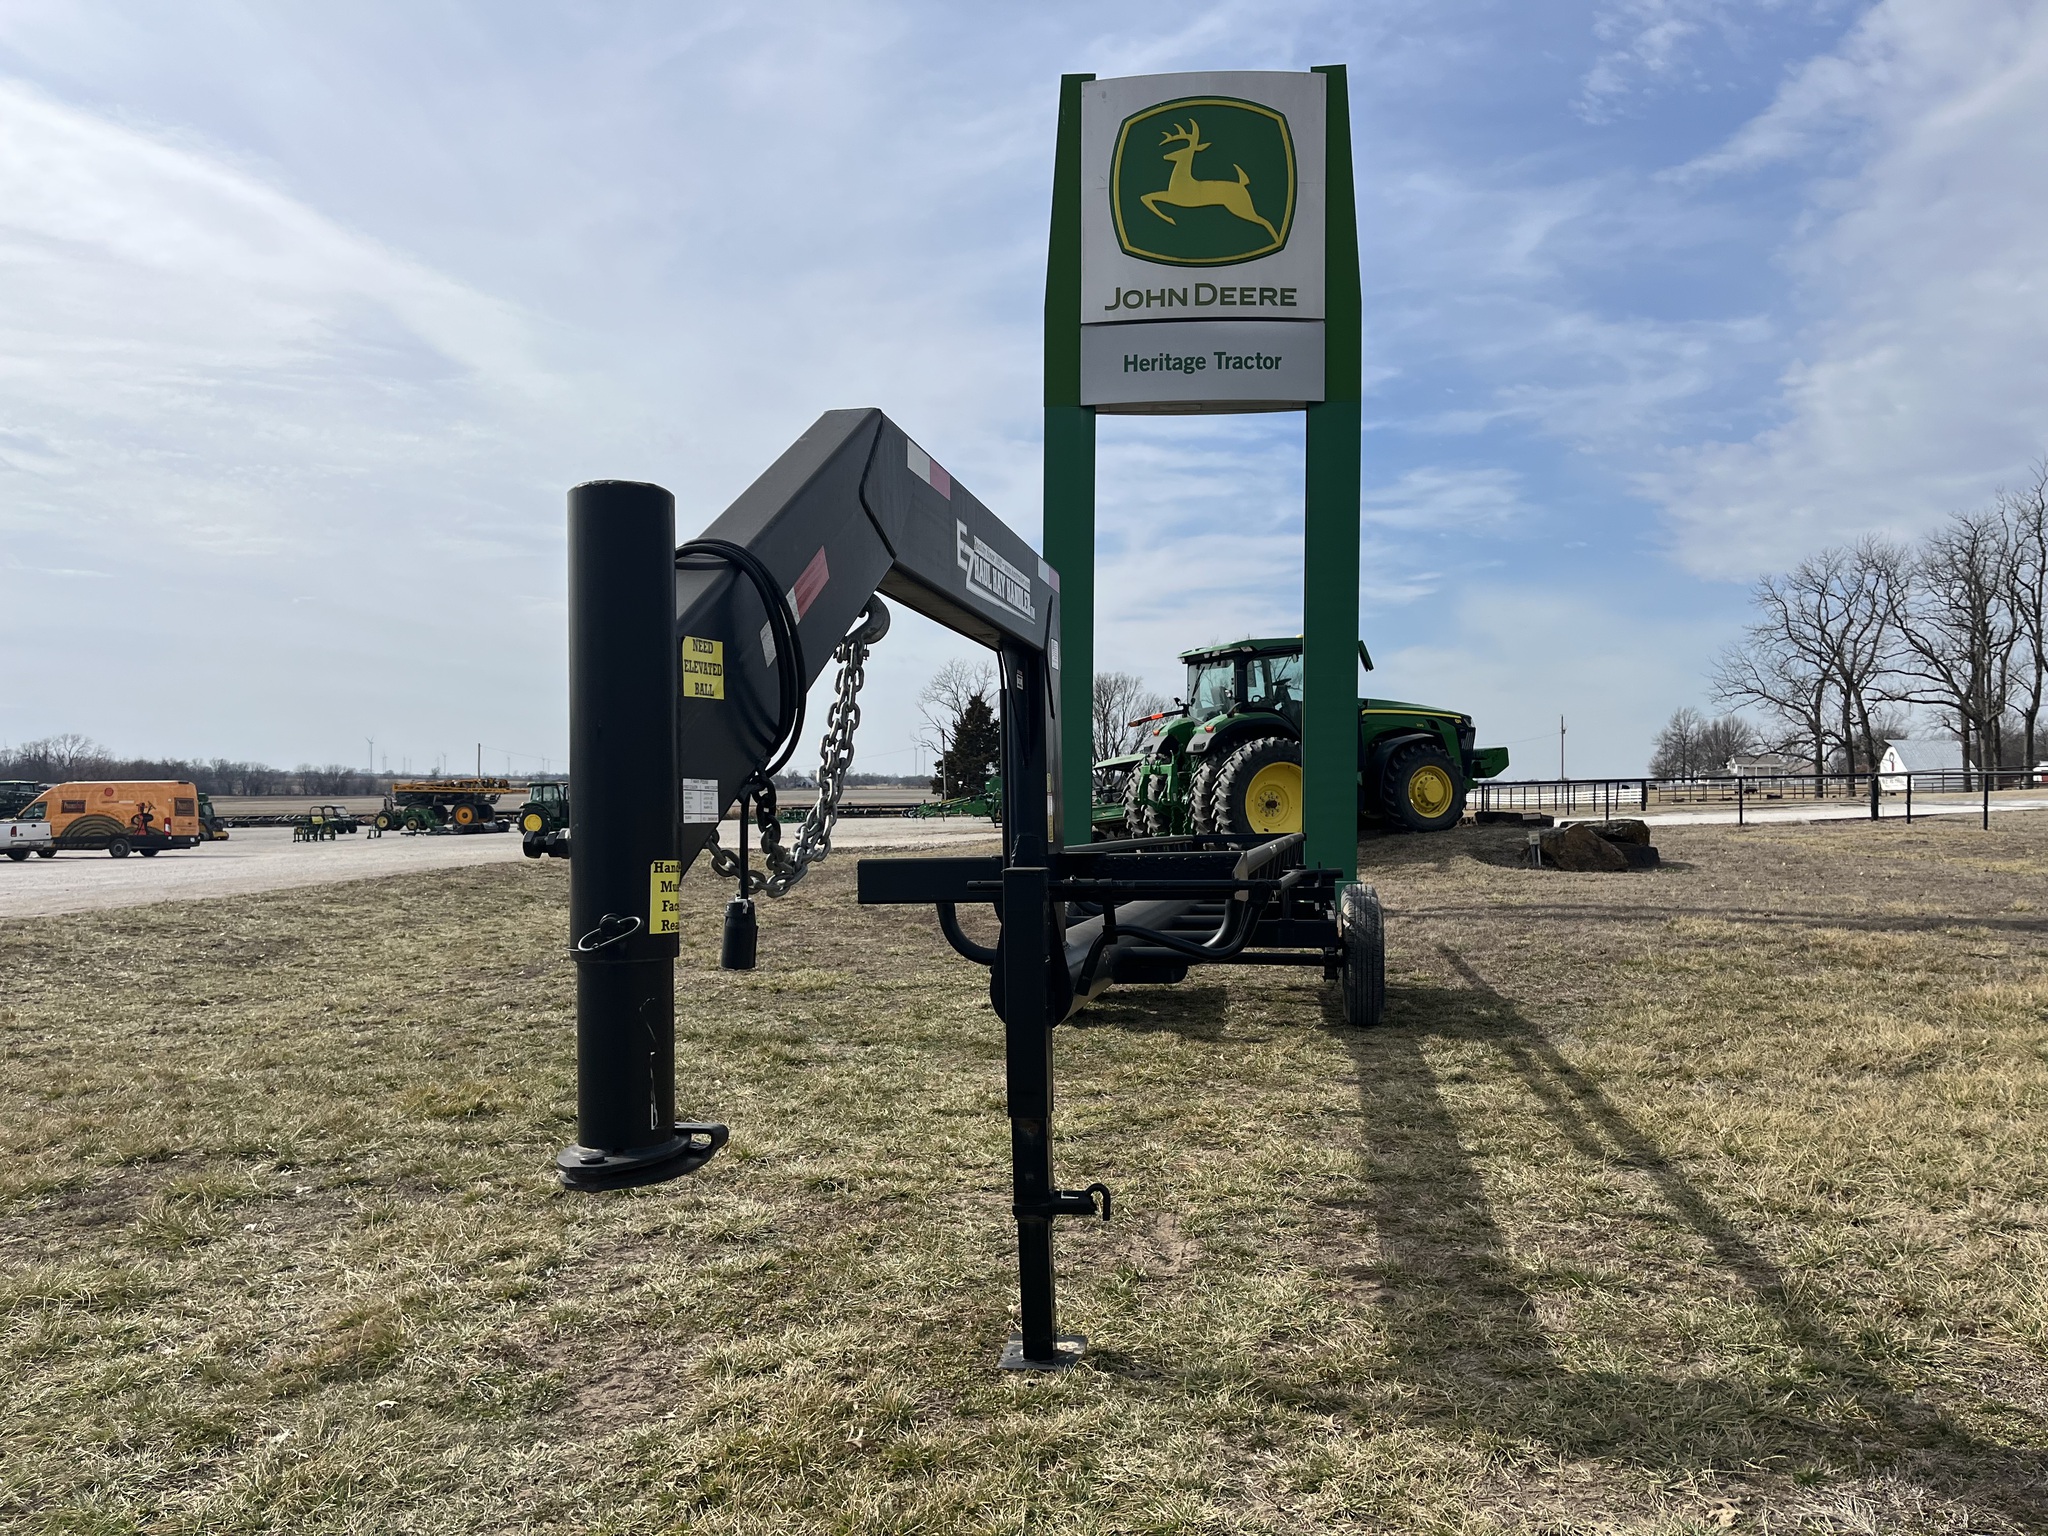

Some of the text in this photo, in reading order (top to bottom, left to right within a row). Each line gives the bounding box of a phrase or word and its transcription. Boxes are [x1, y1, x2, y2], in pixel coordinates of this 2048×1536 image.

[1104, 283, 1297, 311] JOHN DEERE
[1124, 351, 1282, 375] Heritage Tractor
[692, 639, 714, 654] NEED
[684, 659, 723, 677] ELEVATED
[694, 682, 715, 697] BALL
